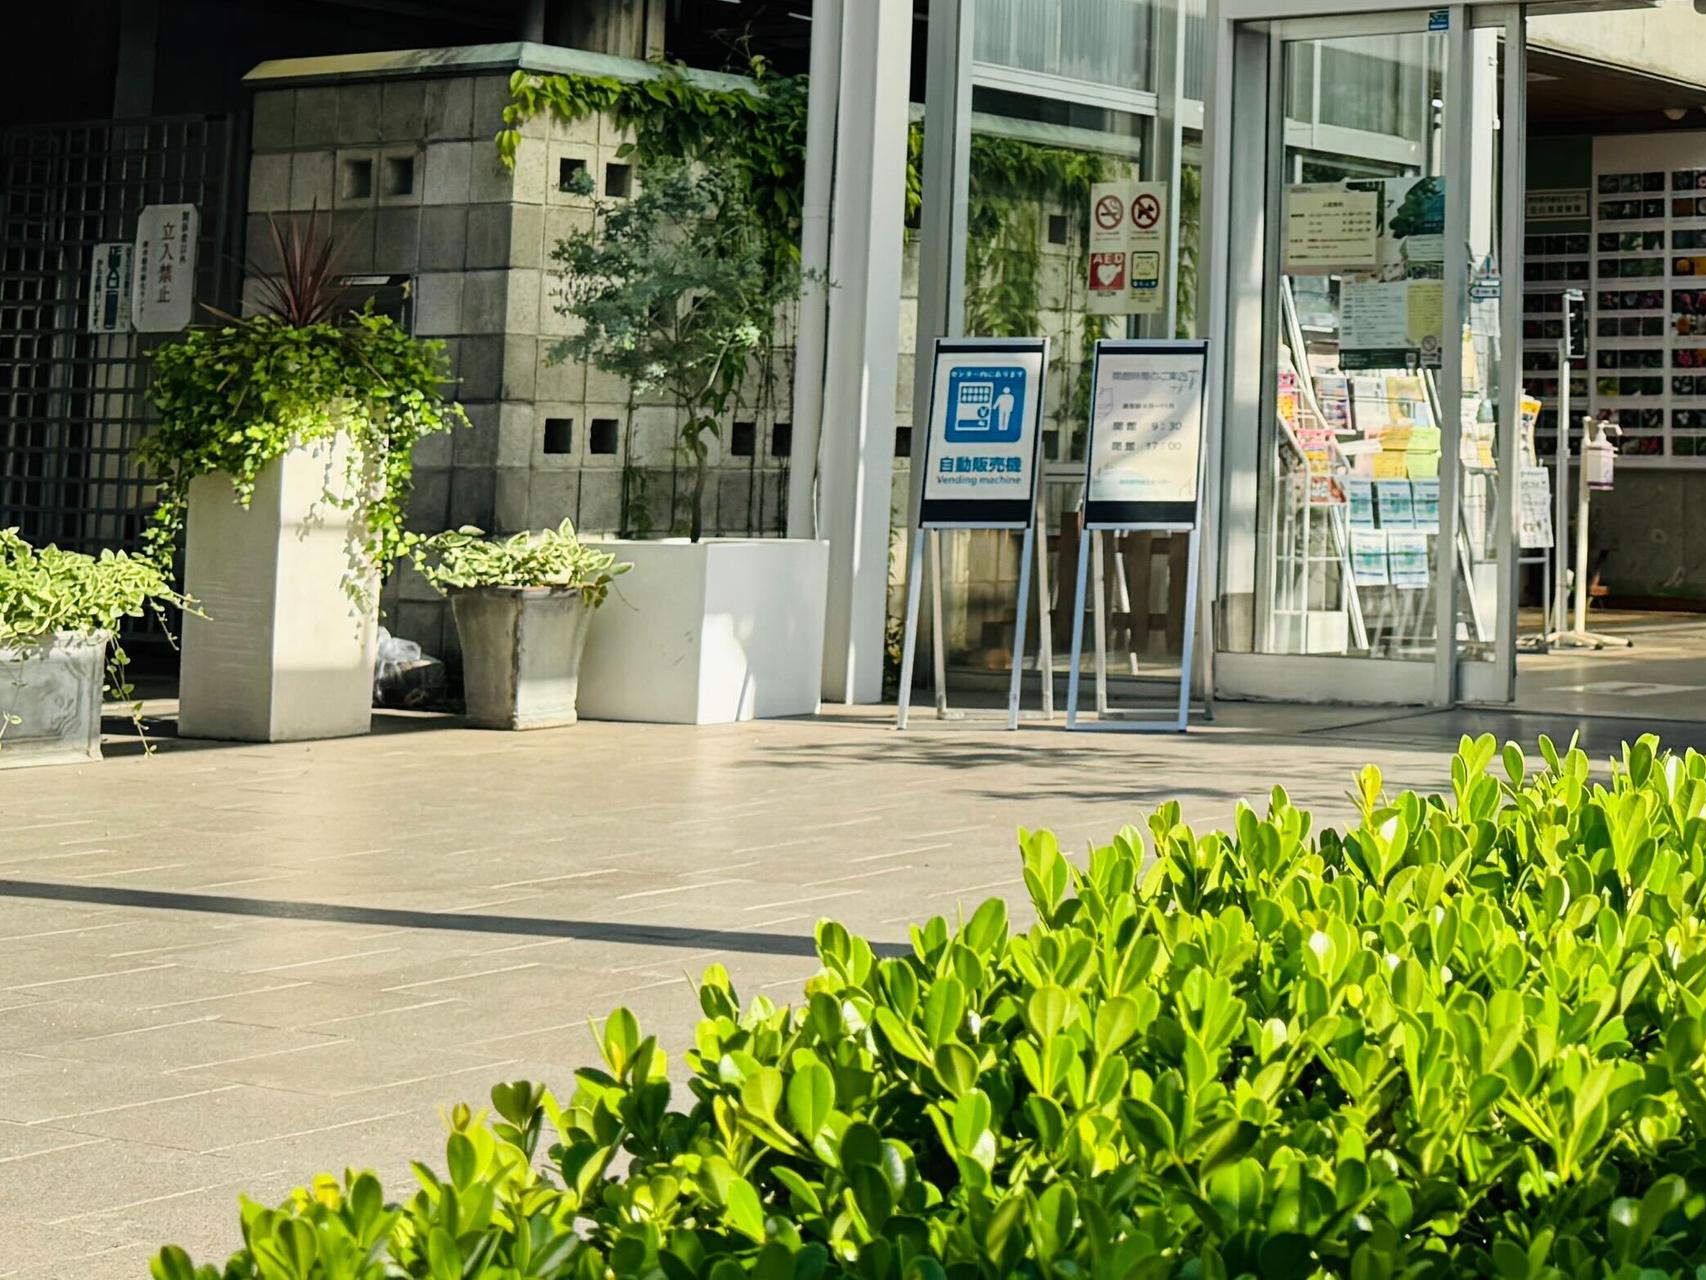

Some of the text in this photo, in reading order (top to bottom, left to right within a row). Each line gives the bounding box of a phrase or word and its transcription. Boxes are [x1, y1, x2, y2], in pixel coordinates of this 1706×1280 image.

[157, 222, 175, 303] 立入禁止
[1093, 254, 1124, 264] AED
[939, 456, 1022, 473] 自動販売機
[937, 475, 1021, 486] Vending machine
